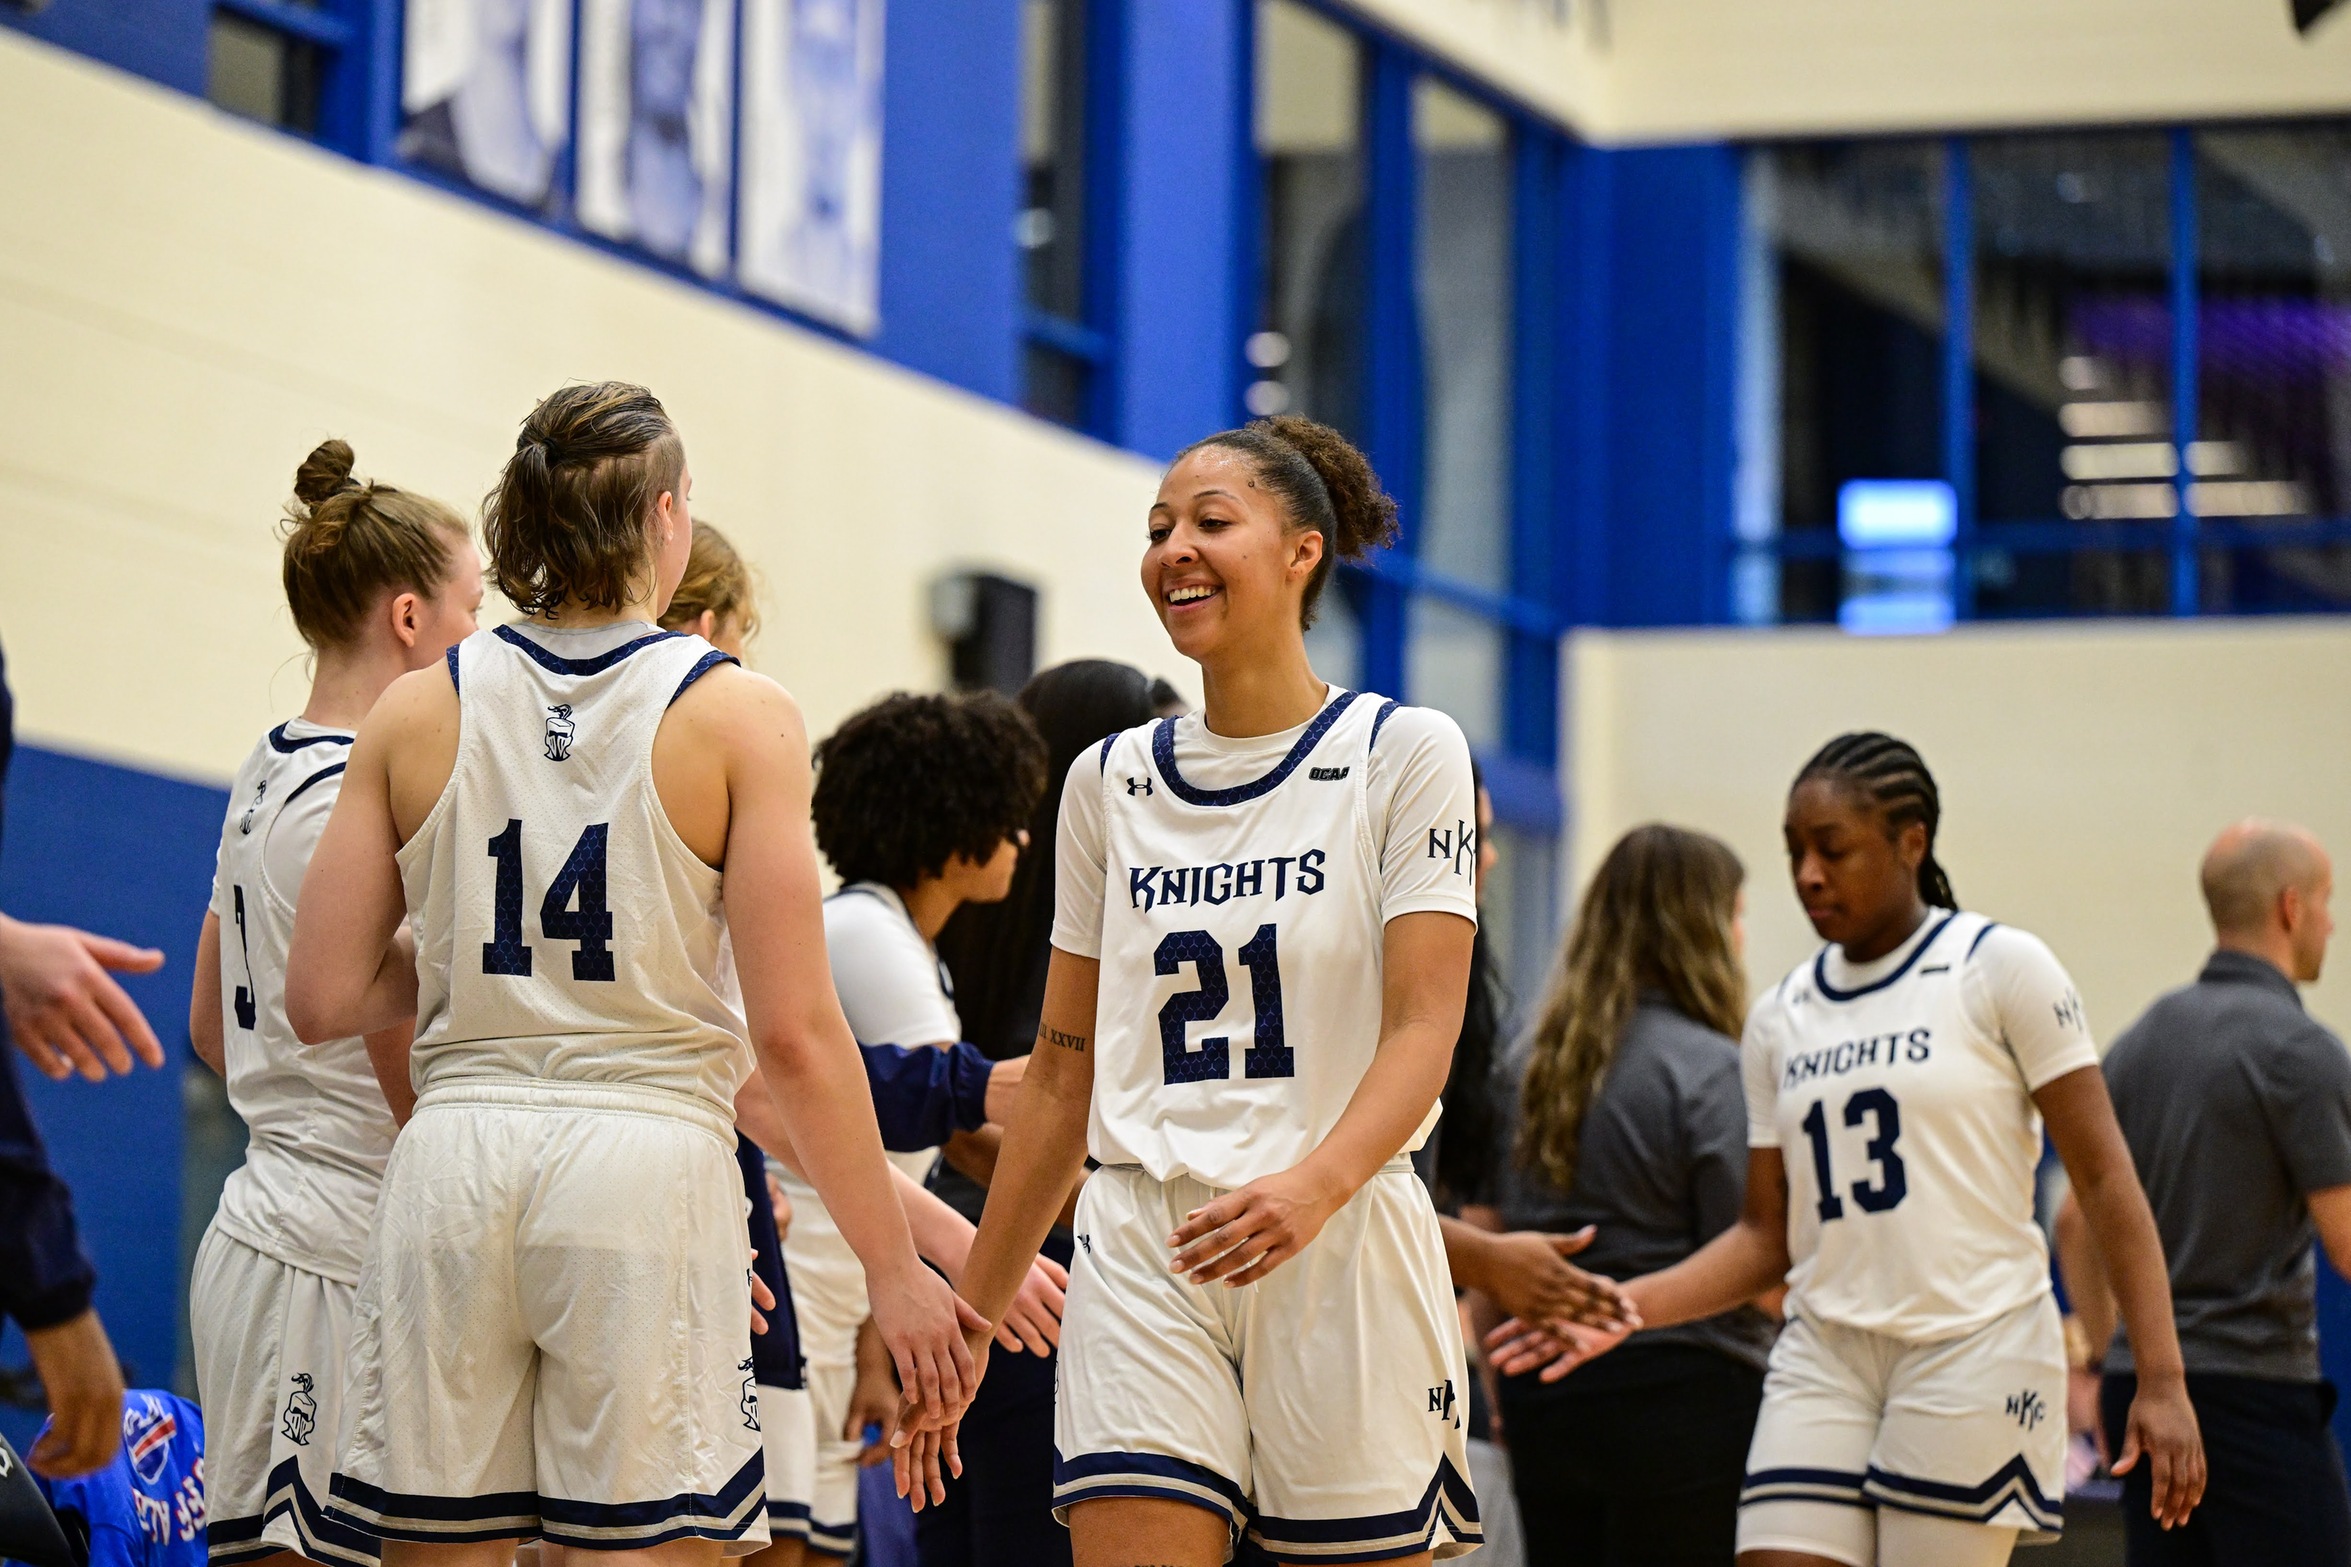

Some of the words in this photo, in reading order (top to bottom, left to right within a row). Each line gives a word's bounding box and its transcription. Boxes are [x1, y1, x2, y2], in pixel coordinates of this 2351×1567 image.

[1308, 766, 1350, 781] OCAA
[1129, 848, 1326, 912] KNIGHTS
[1427, 819, 1476, 886] NK
[482, 818, 616, 982] 14
[1153, 923, 1295, 1085] 21
[1050, 1028, 1086, 1052] XXVII
[1784, 1027, 1931, 1088] KNIGHTS
[1802, 1087, 1907, 1222] 13
